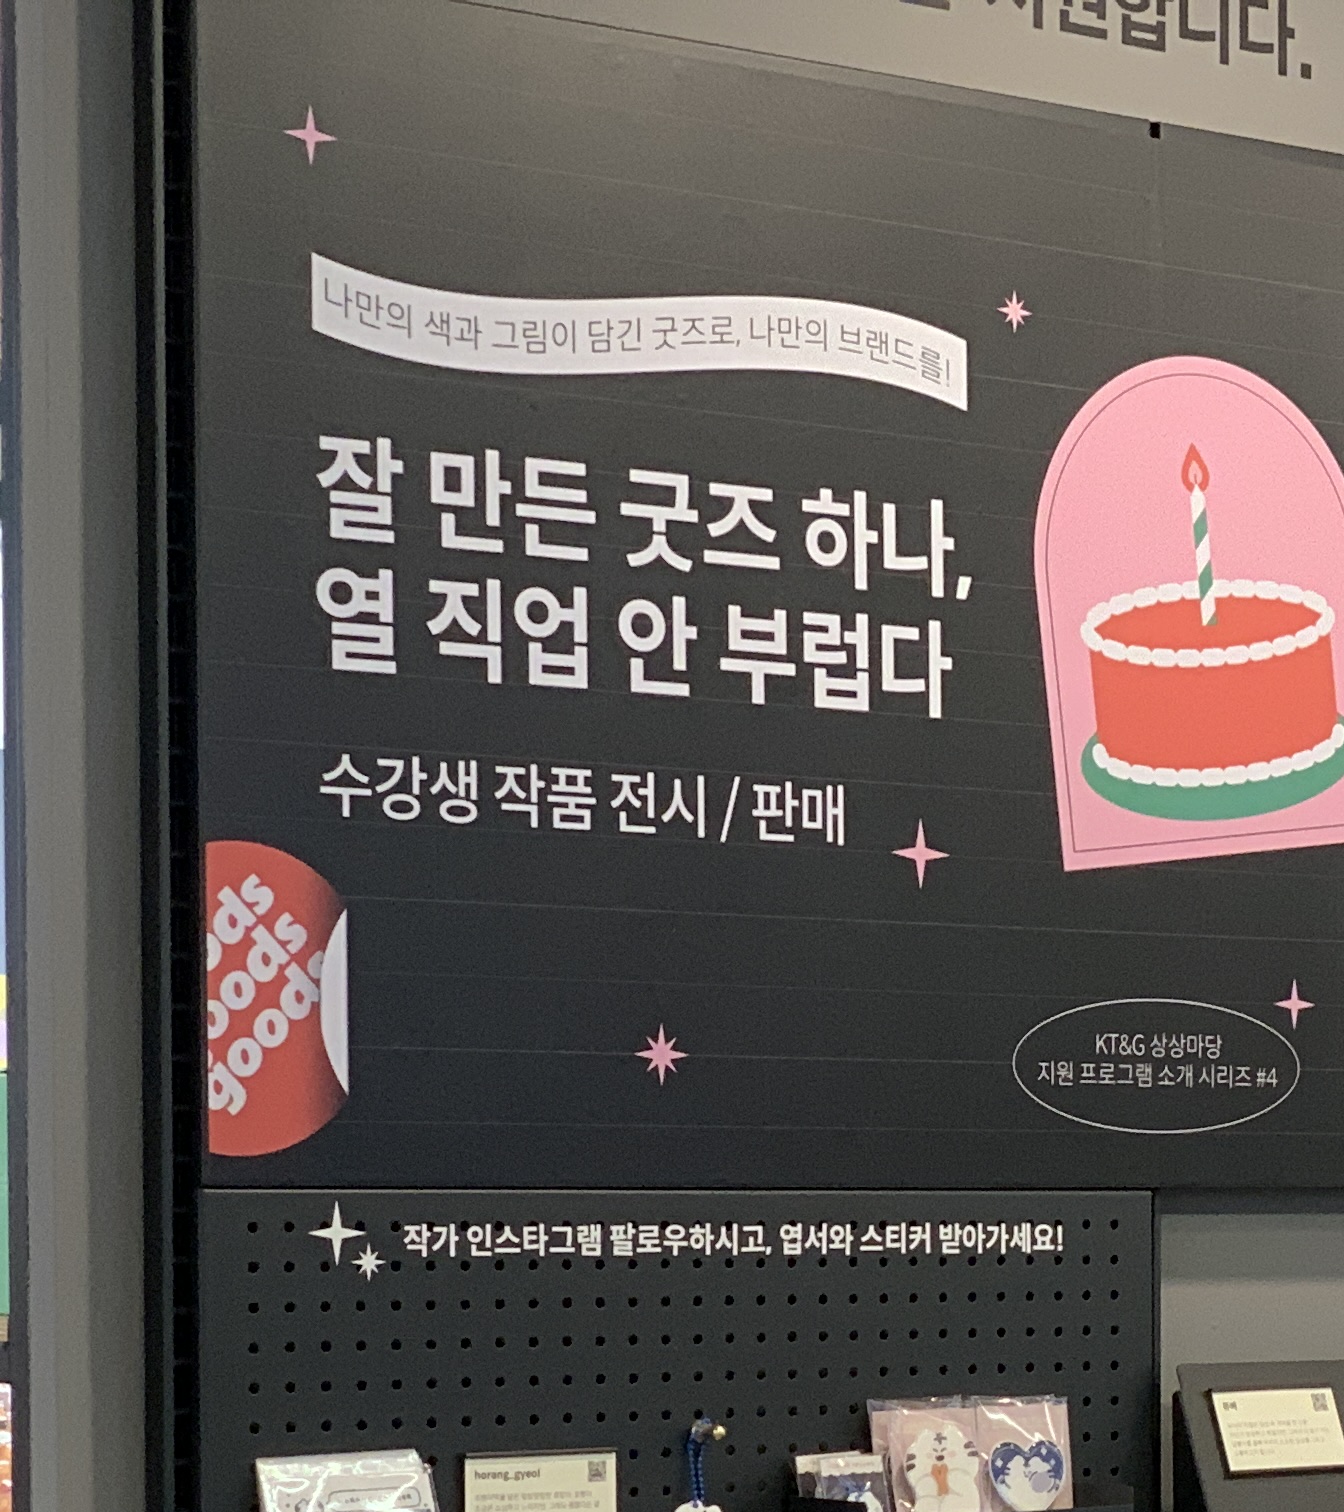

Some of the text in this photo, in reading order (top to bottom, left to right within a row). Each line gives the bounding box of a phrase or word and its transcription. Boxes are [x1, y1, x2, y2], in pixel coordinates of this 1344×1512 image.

[324, 276, 951, 388] 나만의 색과 그림이 담긴 굿즈로, 나만의 브랜드를!
[315, 434, 974, 601] 잘 만든 굿즈 하나,
[314, 566, 953, 720] 열 직업 안 부럽다
[318, 752, 479, 825] 수강생
[493, 763, 598, 832] 작품
[609, 771, 707, 840] 전시
[750, 780, 847, 847] 판매
[1037, 1059, 1279, 1090] 지원 프로그램 소개 시리즈 #4
[1095, 1033, 1223, 1060] KT&G 상상마당
[402, 1221, 1064, 1258] 작가 인스타그램 팔로우하시고, 엽서와 스티커 받아가세요!
[474, 1468, 541, 1483] horang_gyeol
